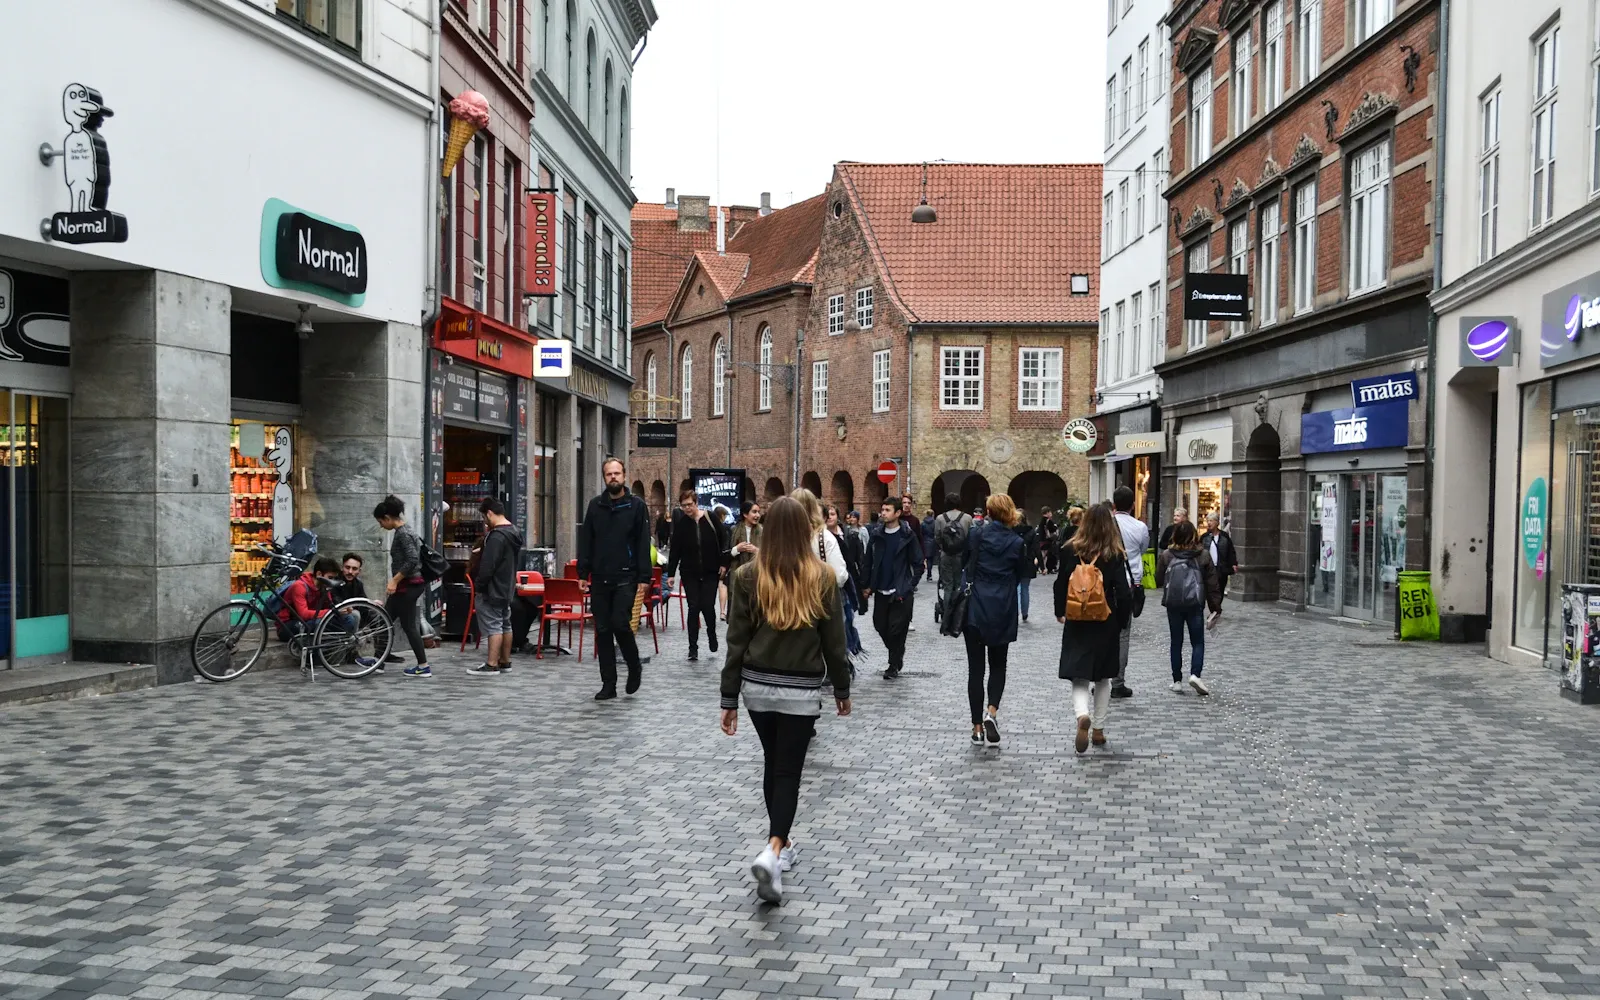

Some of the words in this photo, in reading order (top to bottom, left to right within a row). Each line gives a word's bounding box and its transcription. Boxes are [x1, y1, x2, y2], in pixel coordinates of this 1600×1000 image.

[58, 217, 107, 235] Normal
[531, 198, 552, 286] paradis
[298, 227, 359, 278] Normal
[1359, 379, 1413, 403] matas
[1064, 419, 1095, 435] ESPRESSO
[1333, 413, 1368, 446] matas
[1069, 441, 1092, 450] HOUSE
[1188, 438, 1217, 460] Glitter
[698, 477, 716, 487] PAUL
[1527, 496, 1539, 515] FRI
[1524, 517, 1542, 536] DATA
